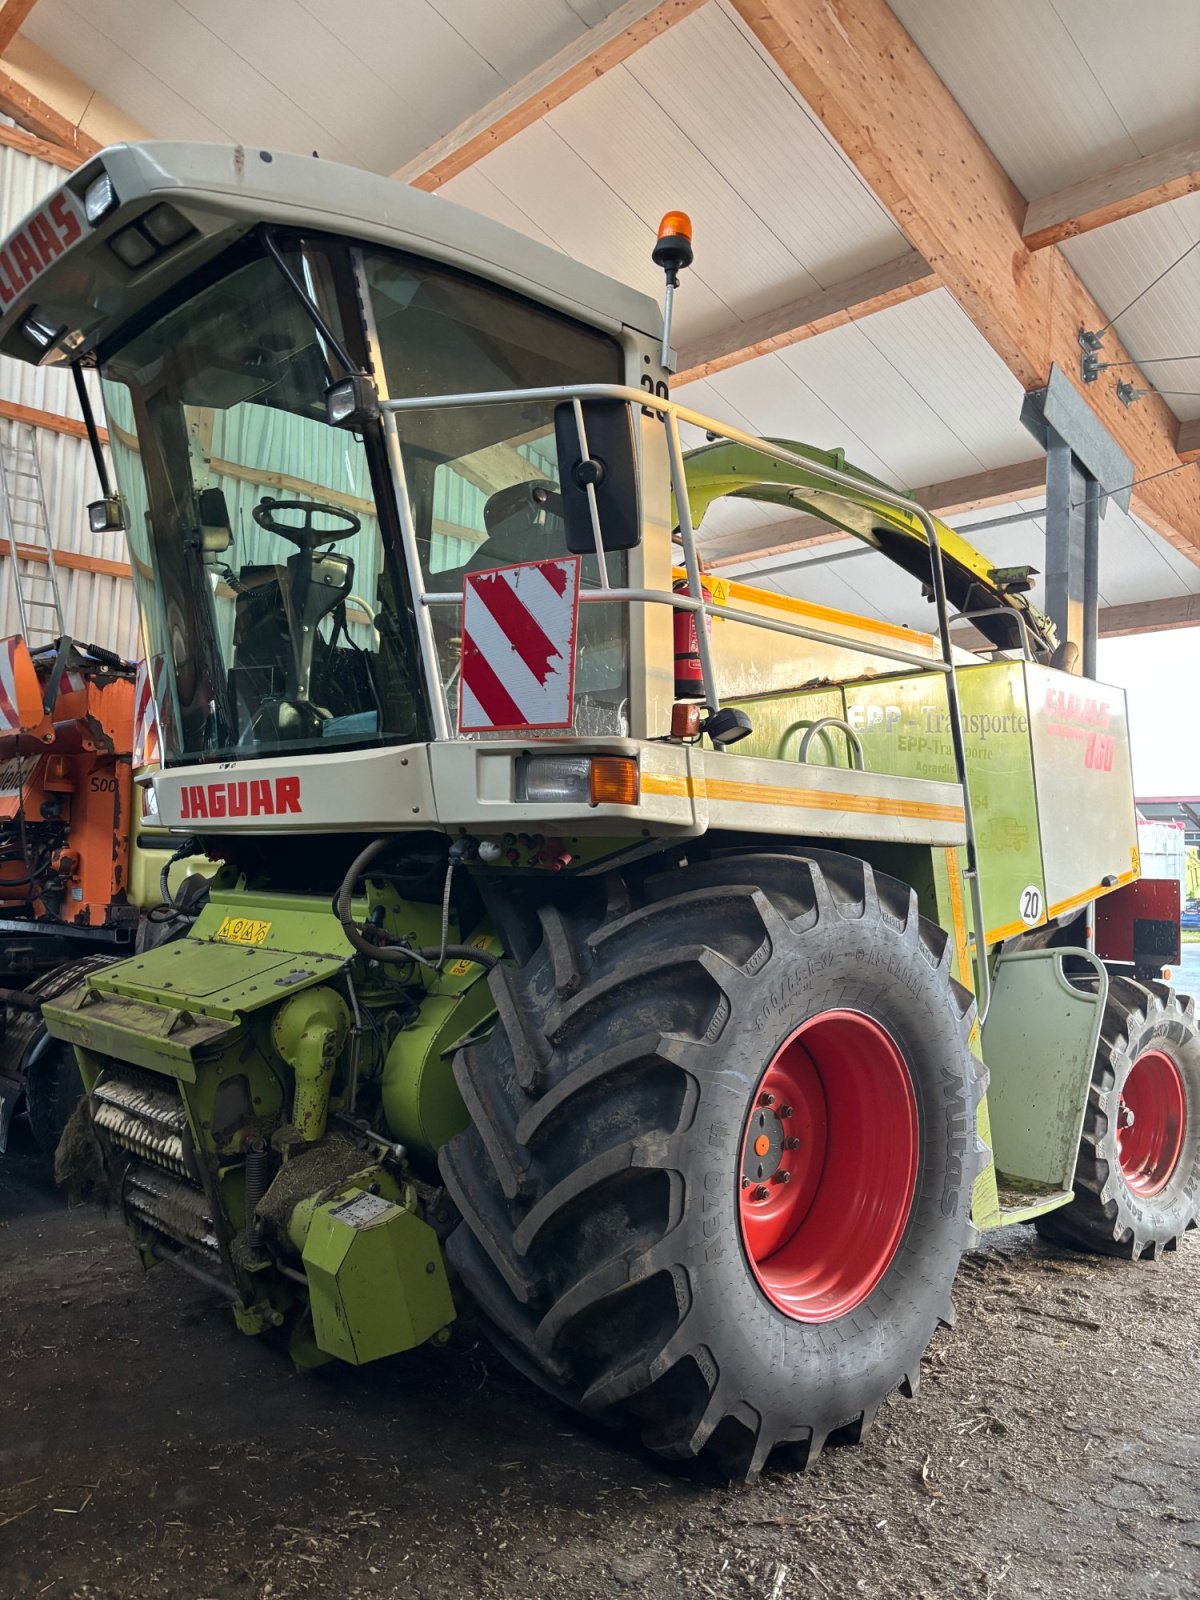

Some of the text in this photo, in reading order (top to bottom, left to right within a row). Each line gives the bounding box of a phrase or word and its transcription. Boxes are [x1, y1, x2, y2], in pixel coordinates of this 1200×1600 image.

[641, 374, 669, 423] 20
[848, 704, 902, 734] EPP
[920, 705, 1027, 740] Transporte
[90, 777, 117, 793] 500
[180, 776, 302, 818] JAGUAR
[1023, 891, 1039, 919] 20
[939, 1064, 967, 1218] Mitas
